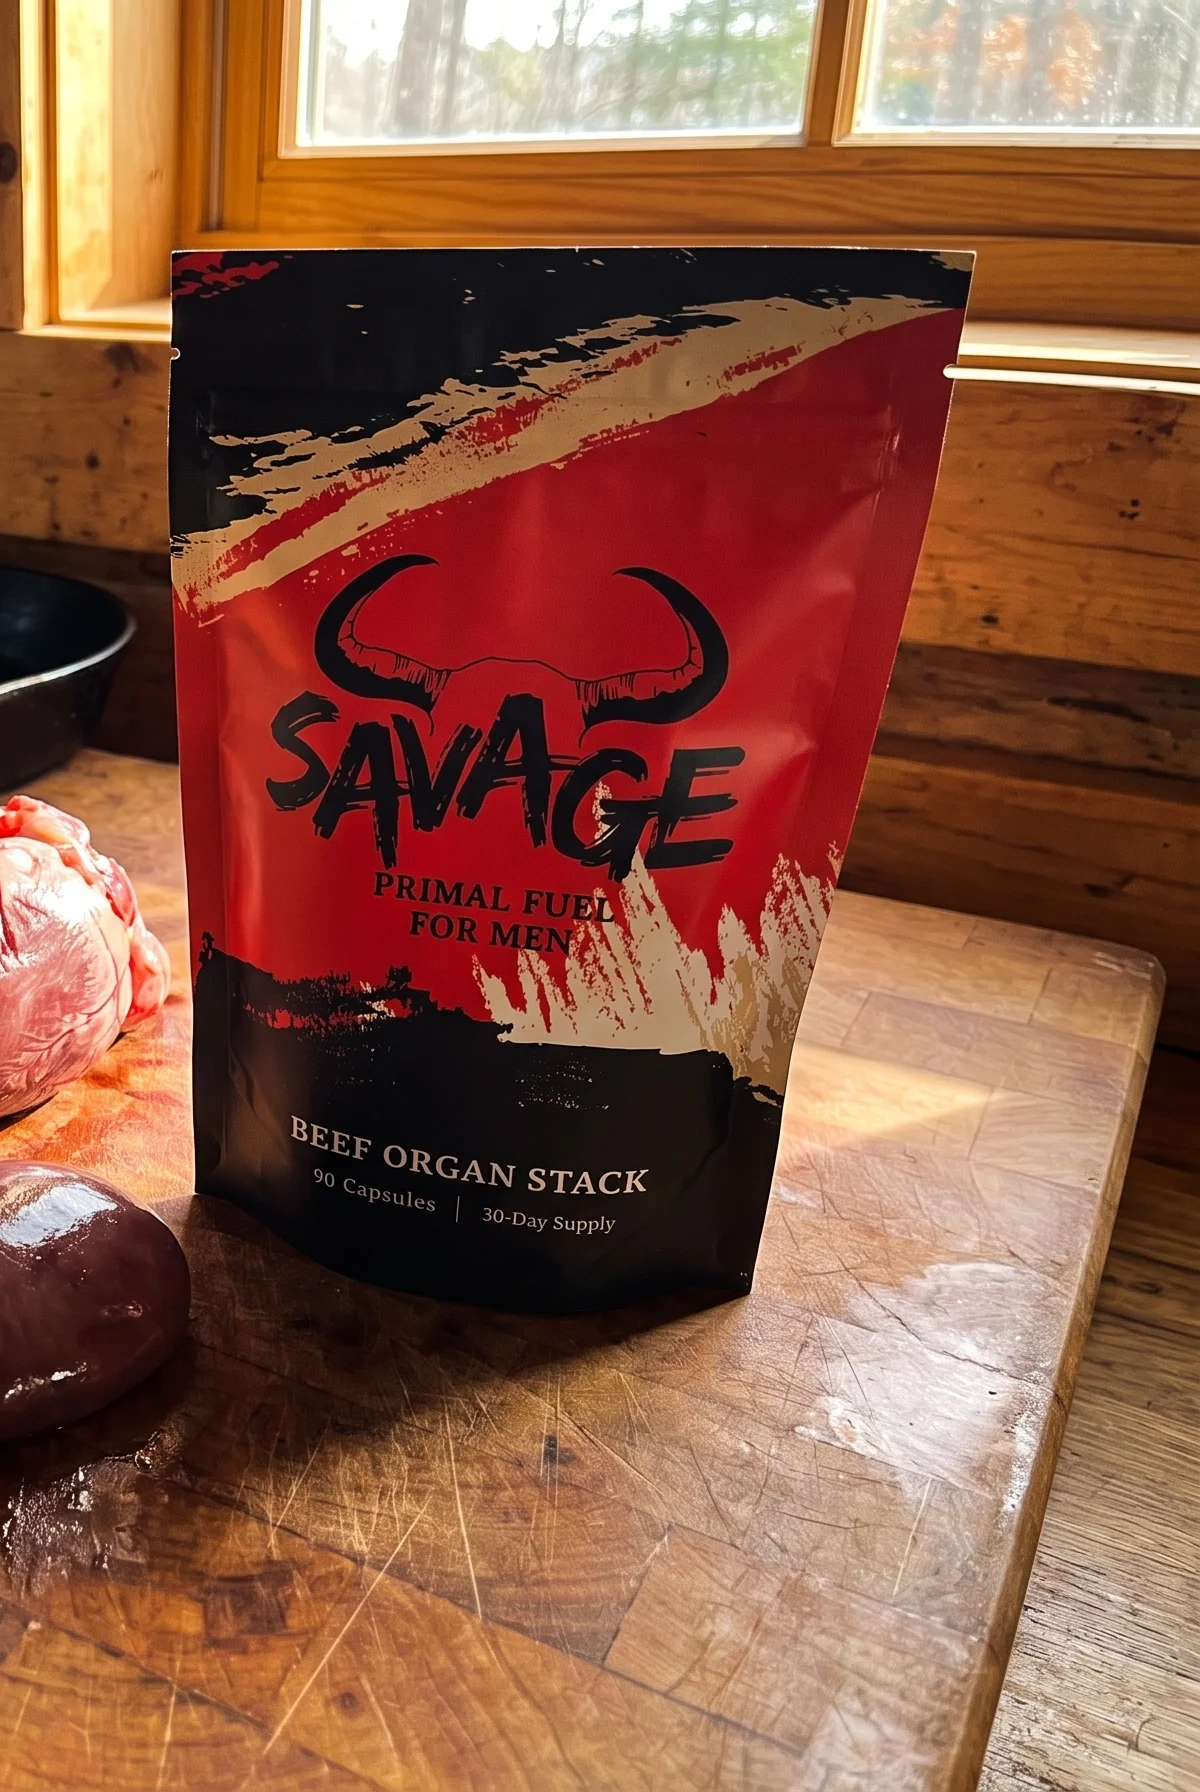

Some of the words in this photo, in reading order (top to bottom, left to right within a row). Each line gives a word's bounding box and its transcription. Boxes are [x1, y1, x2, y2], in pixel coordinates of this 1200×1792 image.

[265, 690, 746, 882] SAVAGE
[373, 870, 509, 913] PRIMAL
[522, 889, 616, 924] FUEL
[408, 911, 479, 944] FOR
[489, 920, 573, 955] MEN
[290, 1114, 373, 1161] BEEF
[383, 1144, 517, 1188] ORGAN
[526, 1167, 650, 1196] STACK
[313, 1168, 336, 1188] 90
[343, 1178, 437, 1213] Capsules
[482, 1207, 549, 1233] 30-Day
[553, 1215, 617, 1235] Supply
